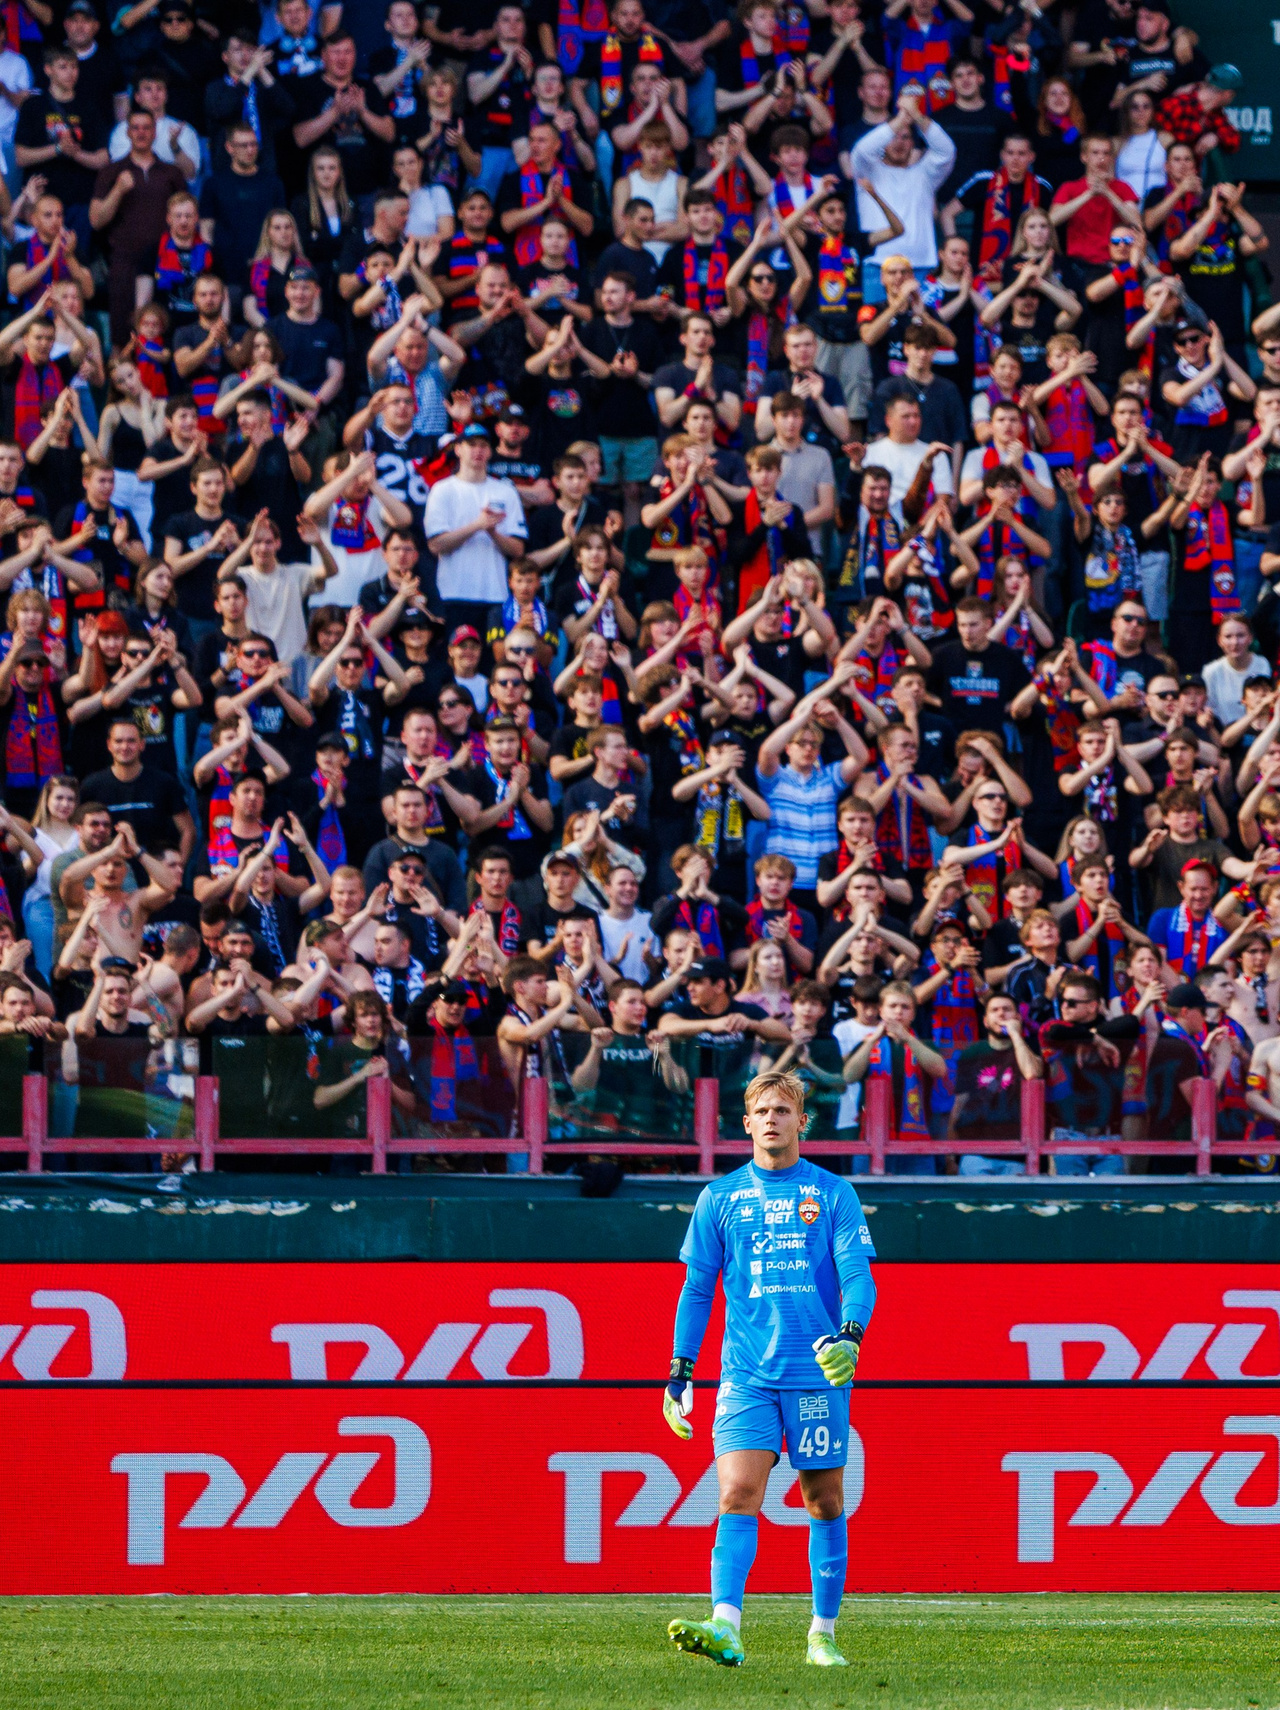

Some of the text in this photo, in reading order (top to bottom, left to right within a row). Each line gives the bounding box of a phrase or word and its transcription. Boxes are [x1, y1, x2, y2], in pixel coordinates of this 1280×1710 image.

[739, 1188, 761, 1198] ПСБ
[763, 1199, 794, 1212] FON
[763, 1212, 793, 1225] BET
[775, 1240, 806, 1250] ЗНАК
[766, 1260, 810, 1271] Р-ФАРМ
[799, 1395, 828, 1408] ВЭБ
[798, 1425, 830, 1458] 49
